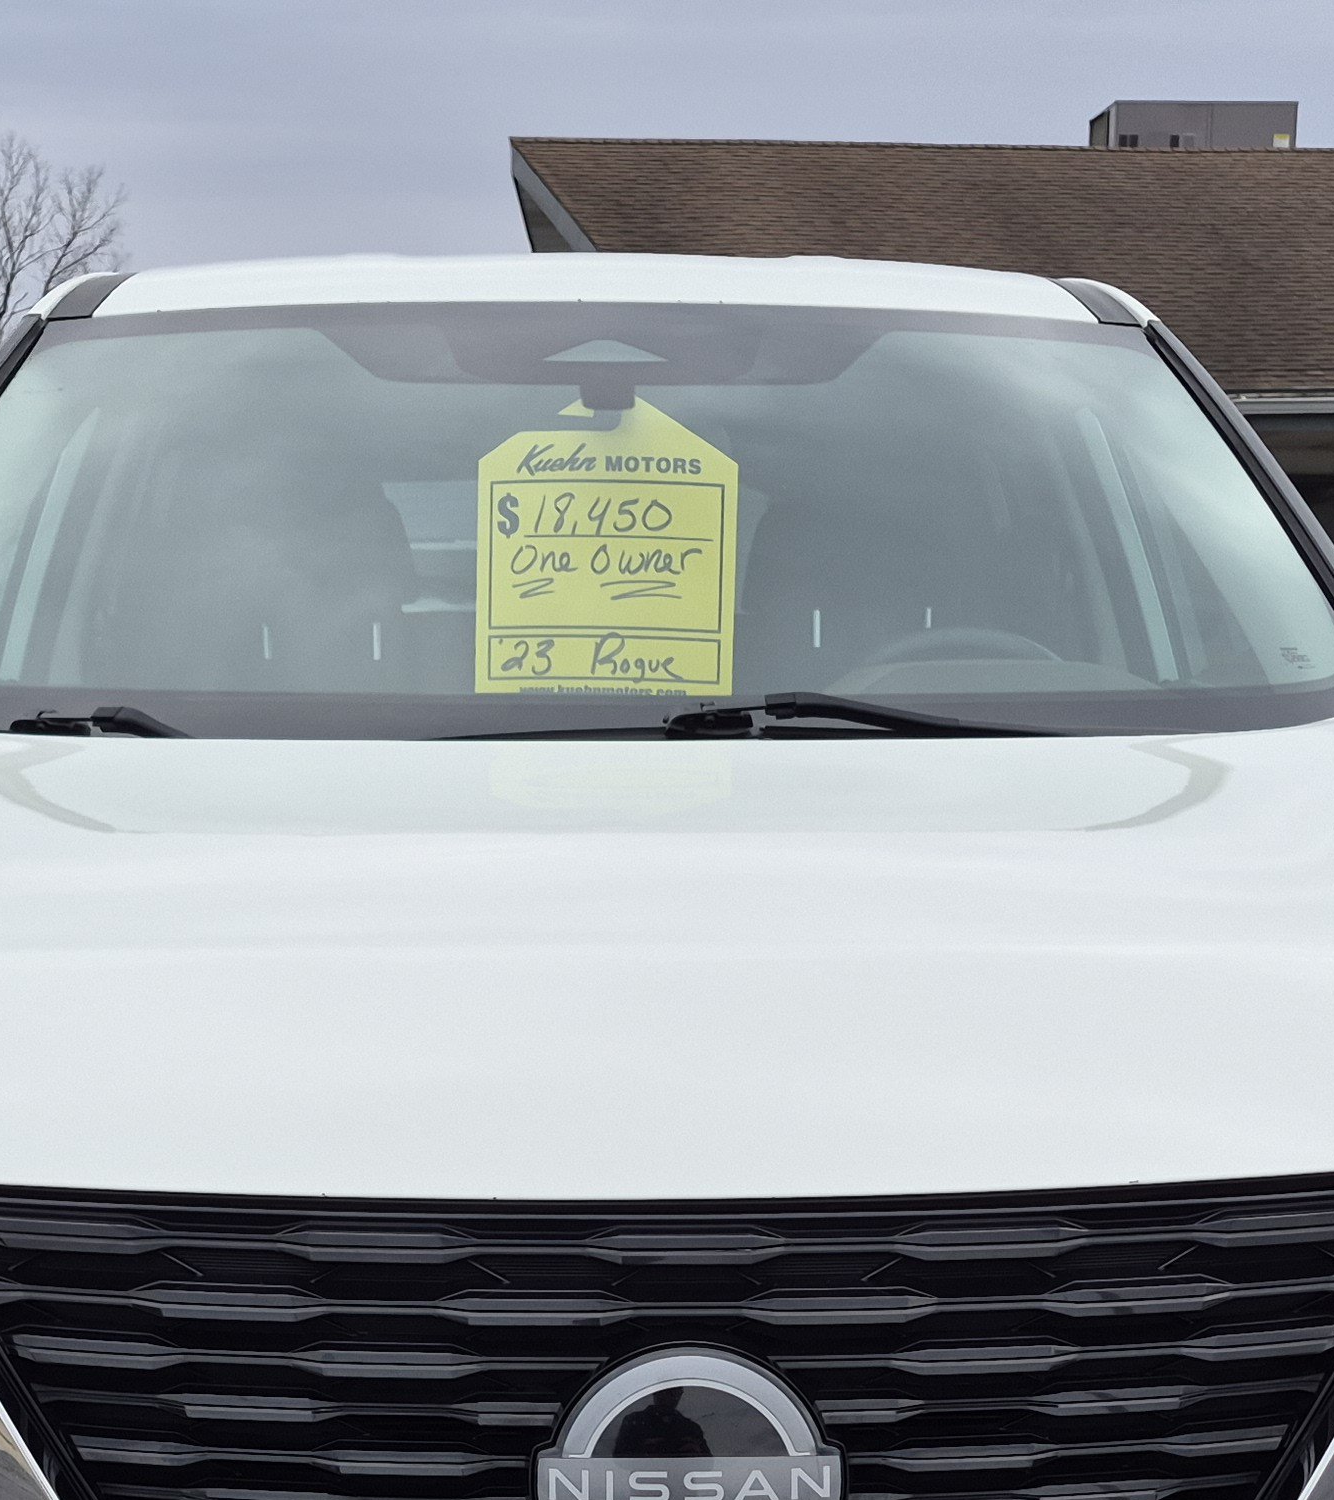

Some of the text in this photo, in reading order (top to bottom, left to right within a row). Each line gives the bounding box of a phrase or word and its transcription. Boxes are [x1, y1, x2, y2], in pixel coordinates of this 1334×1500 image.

[517, 443, 702, 476] Kuehn MOTORS
[510, 543, 703, 576] One Owner
[590, 632, 686, 683] Rogue
[519, 684, 687, 696] wwwkuehnmotorscom
